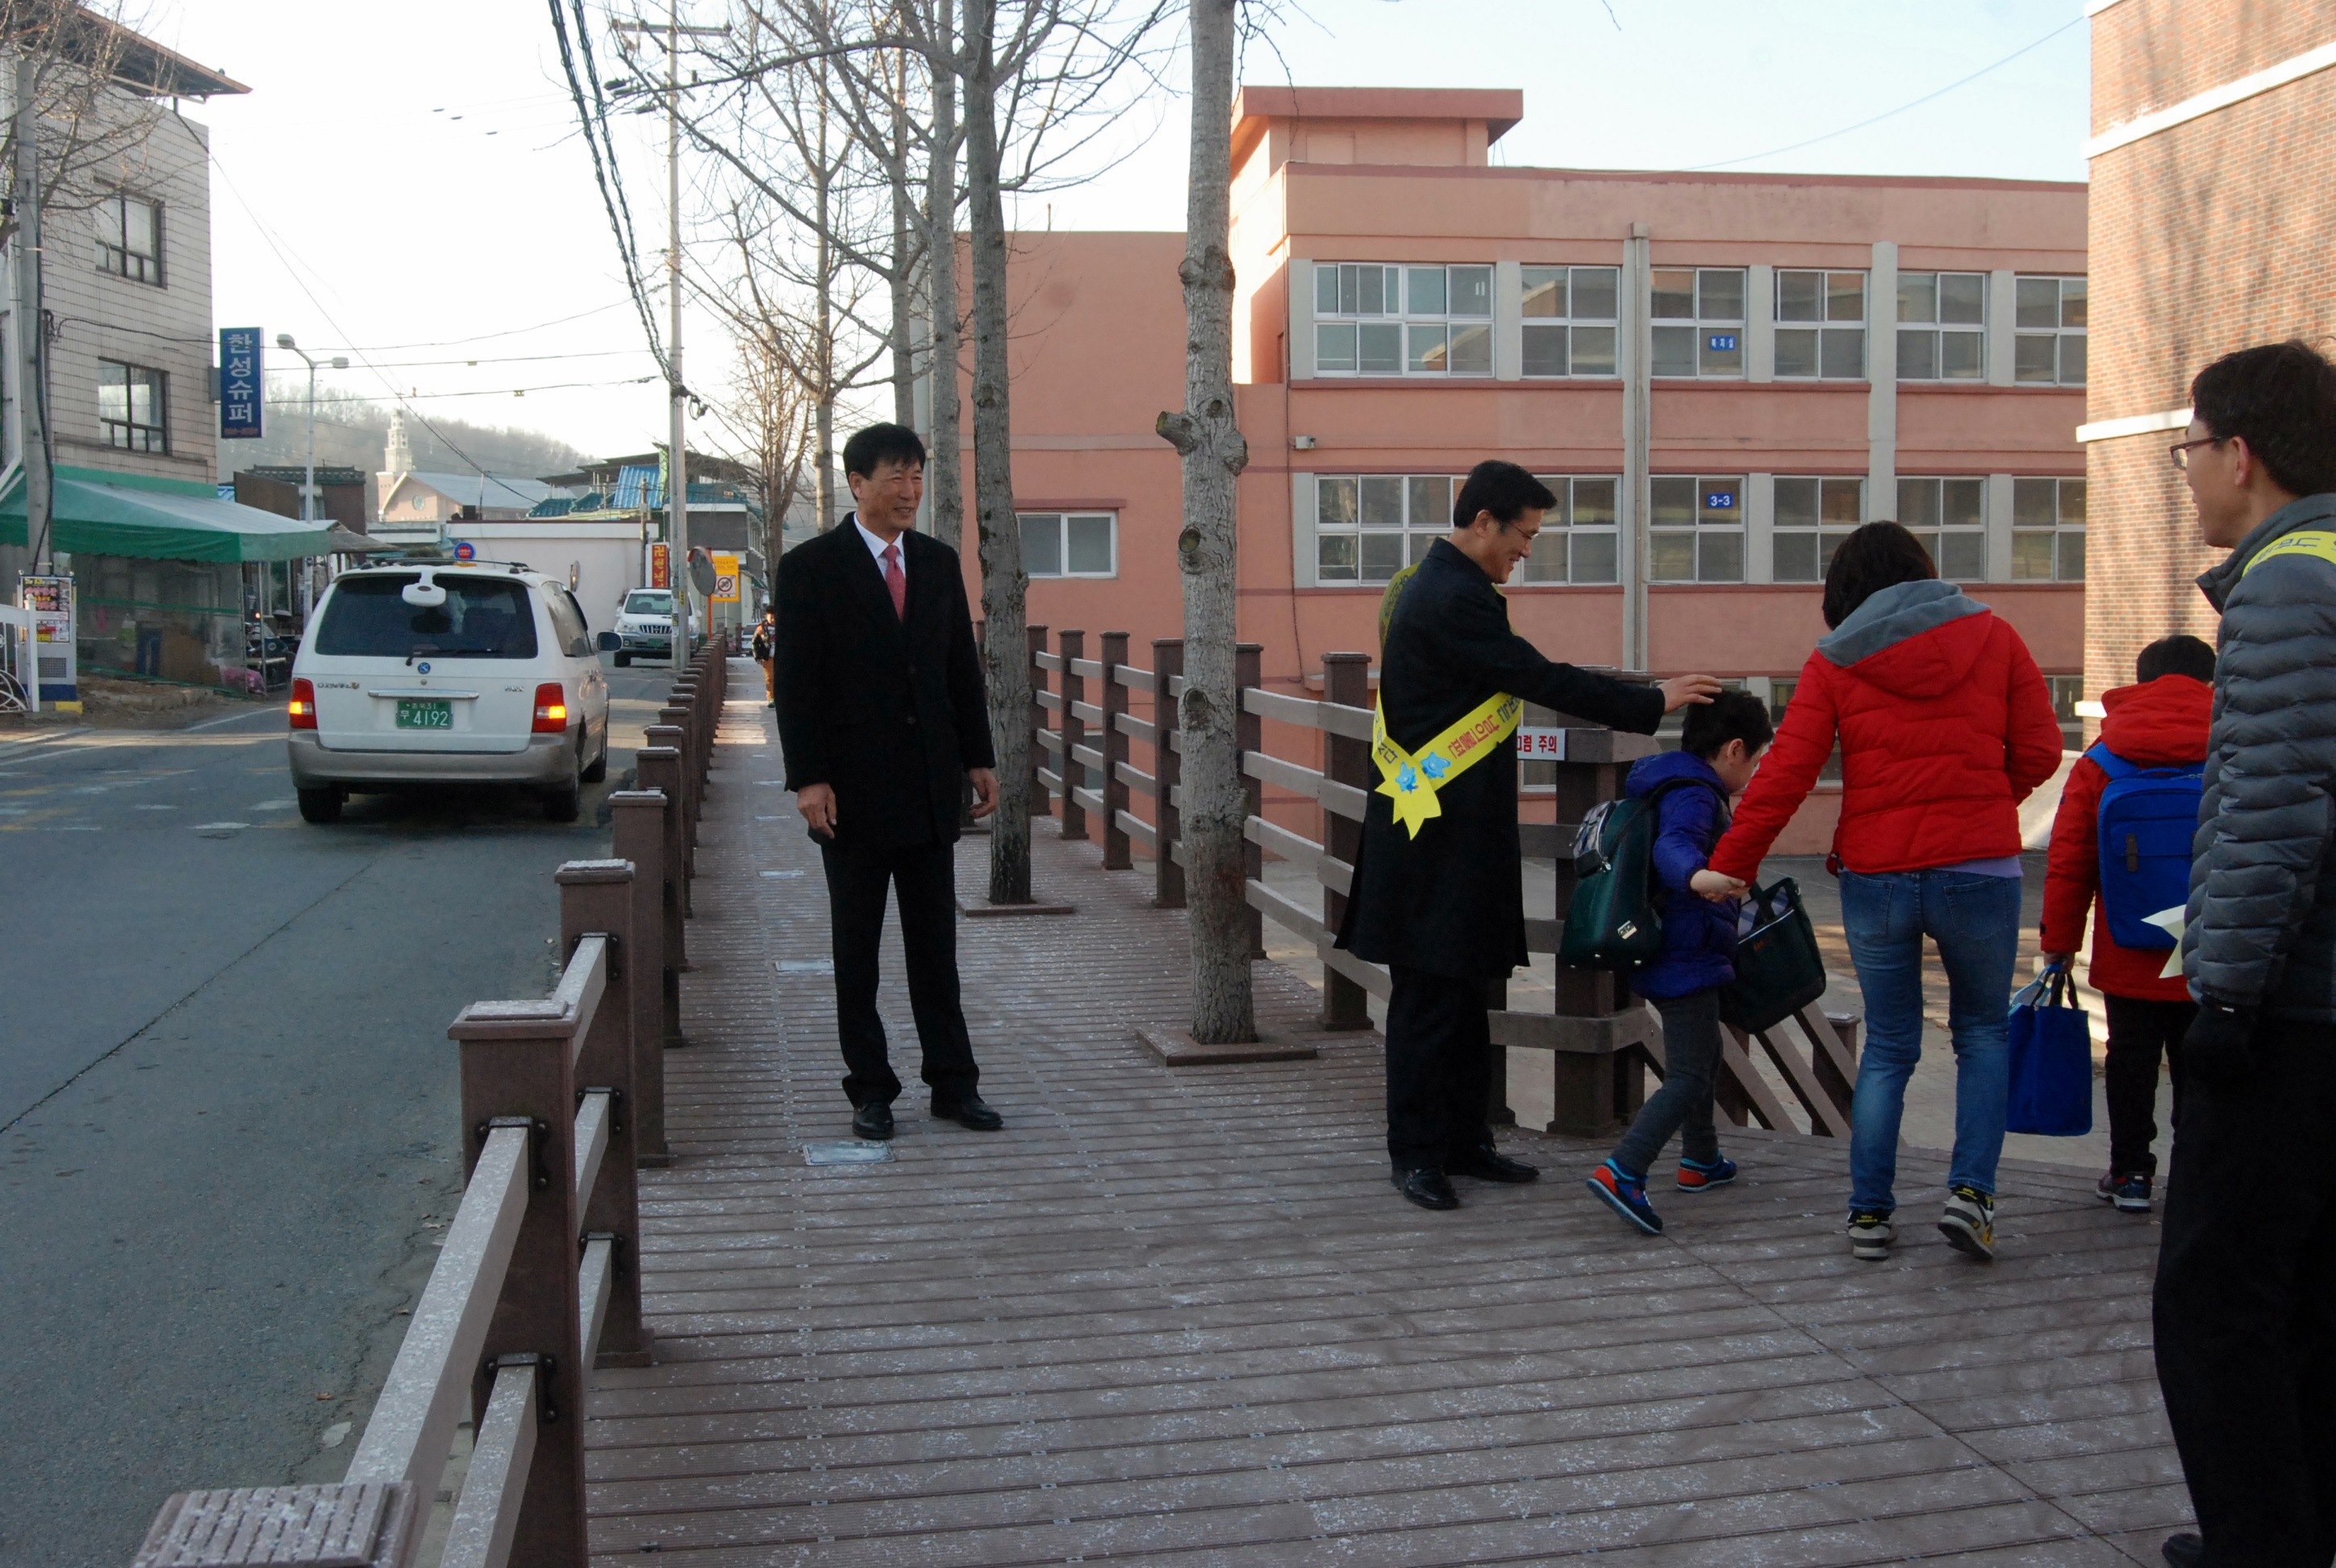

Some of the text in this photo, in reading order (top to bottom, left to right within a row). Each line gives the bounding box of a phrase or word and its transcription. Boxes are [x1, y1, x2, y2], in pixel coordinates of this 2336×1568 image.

[227, 333, 253, 423] 한성슈퍼
[1710, 495, 1730, 507] 3-3
[413, 710, 448, 726] 4192
[1538, 735, 1557, 753] 주의
